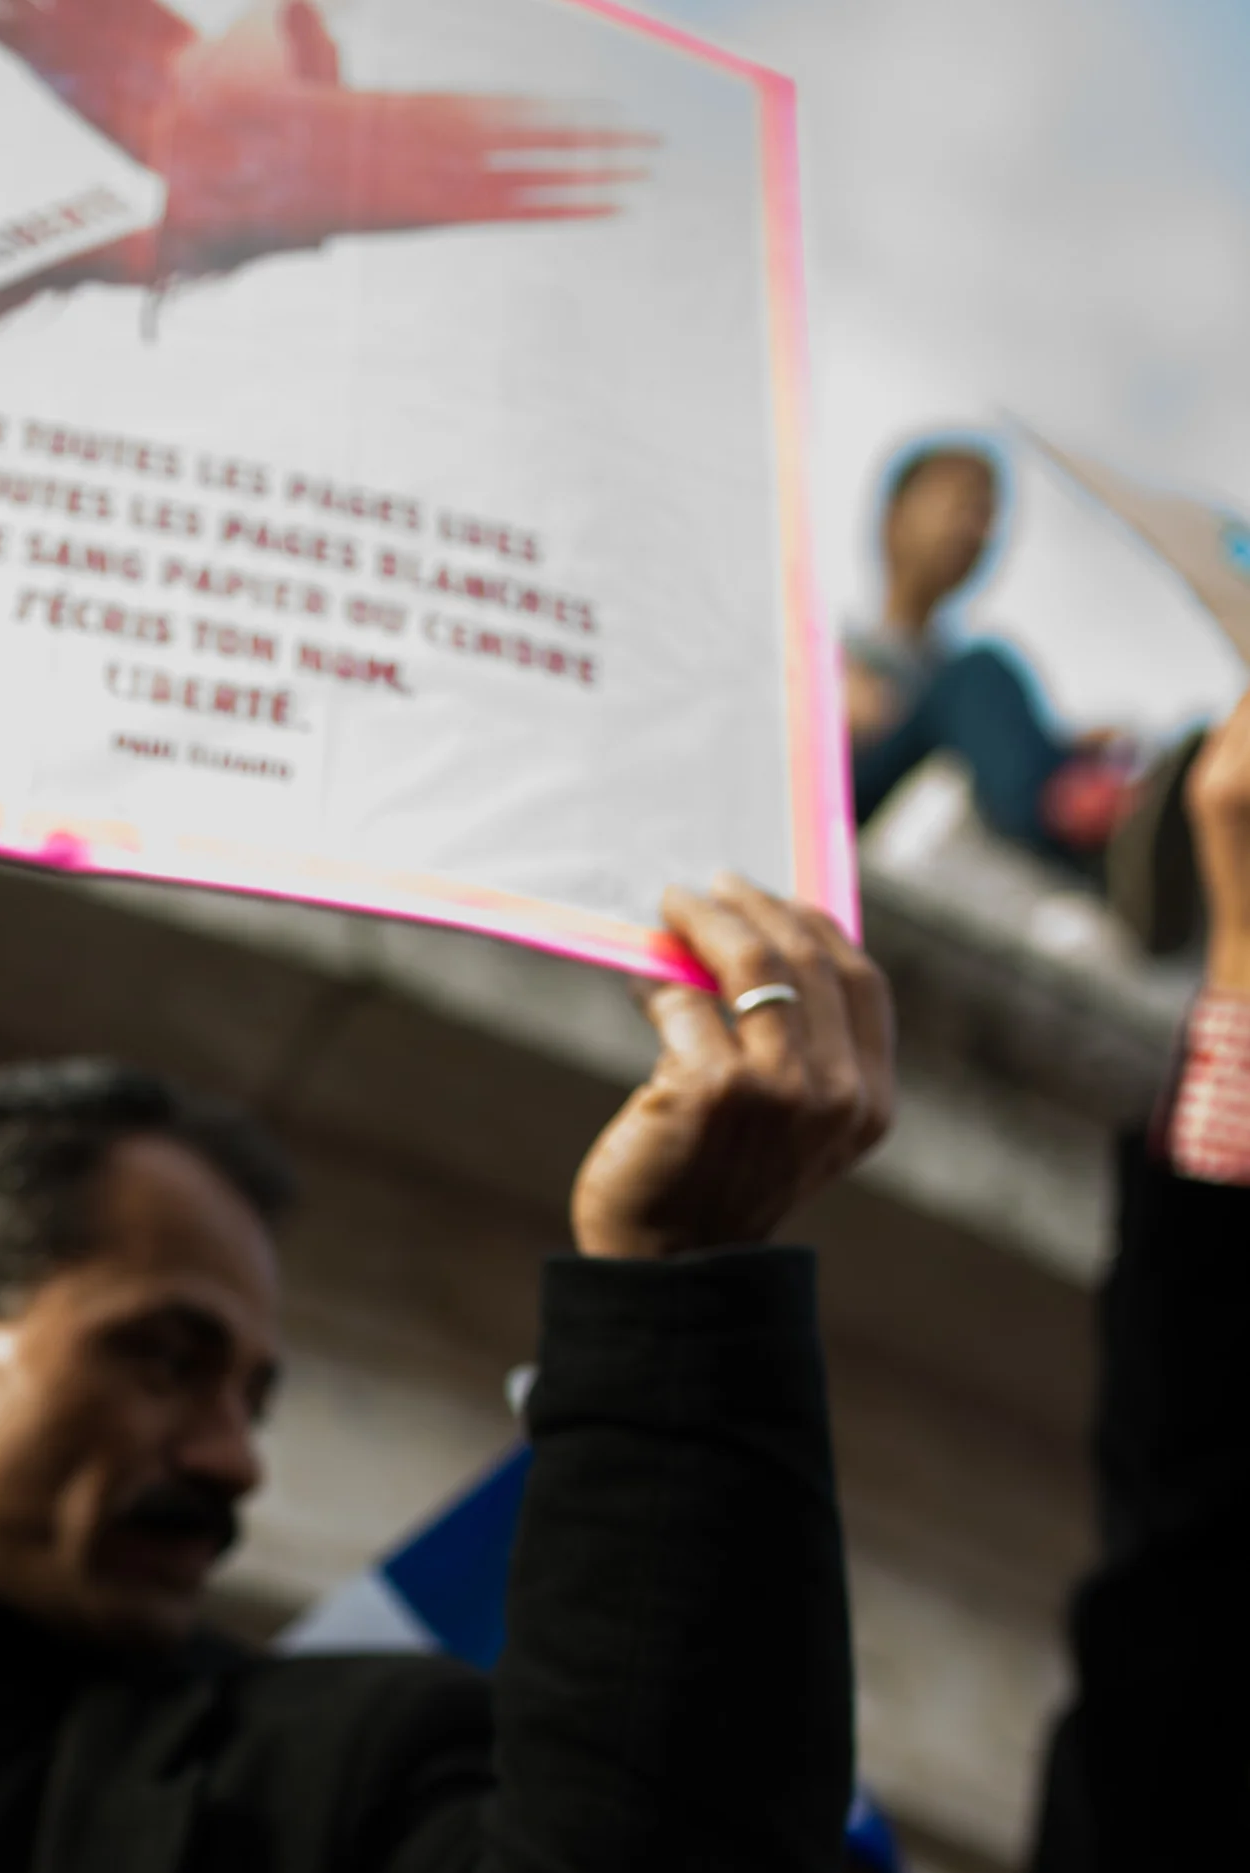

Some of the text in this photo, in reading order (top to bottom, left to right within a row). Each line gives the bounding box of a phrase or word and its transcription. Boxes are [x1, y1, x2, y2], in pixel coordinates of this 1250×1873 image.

[25, 417, 181, 478] TOUTES
[197, 453, 271, 496] LES
[286, 470, 422, 530] PAGES
[26, 531, 146, 580] SANG
[161, 555, 326, 616] PAPIER
[346, 592, 405, 633] OU
[424, 609, 601, 687] CENDRE
[130, 494, 201, 538] LES
[218, 514, 360, 571] PAGES
[375, 548, 599, 634] BLANCHES
[191, 618, 278, 664] TON
